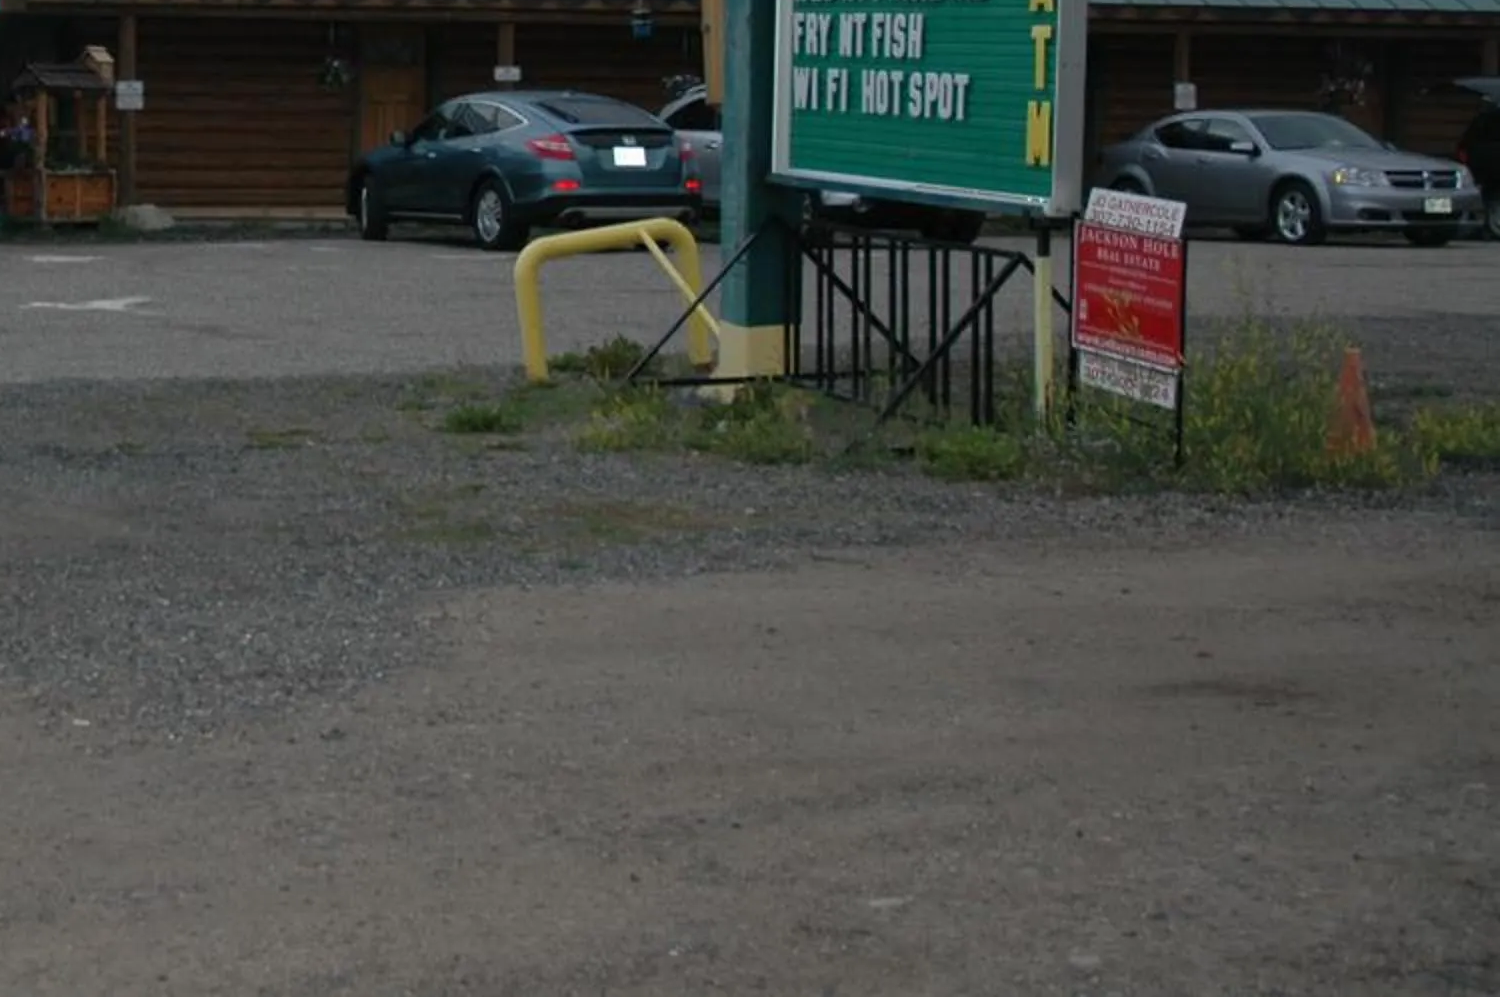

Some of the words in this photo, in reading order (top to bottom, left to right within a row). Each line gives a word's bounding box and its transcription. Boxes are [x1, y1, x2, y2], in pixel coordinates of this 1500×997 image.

[792, 12, 831, 56] FRY
[839, 12, 867, 57] NT
[871, 12, 924, 59] FISH
[861, 69, 903, 116] HOT
[907, 71, 970, 121] SPOT
[1081, 226, 1138, 249] JACKSON
[1143, 238, 1179, 259] HOLE
[1097, 246, 1120, 263] REAL
[1123, 252, 1161, 271] ESTATE
